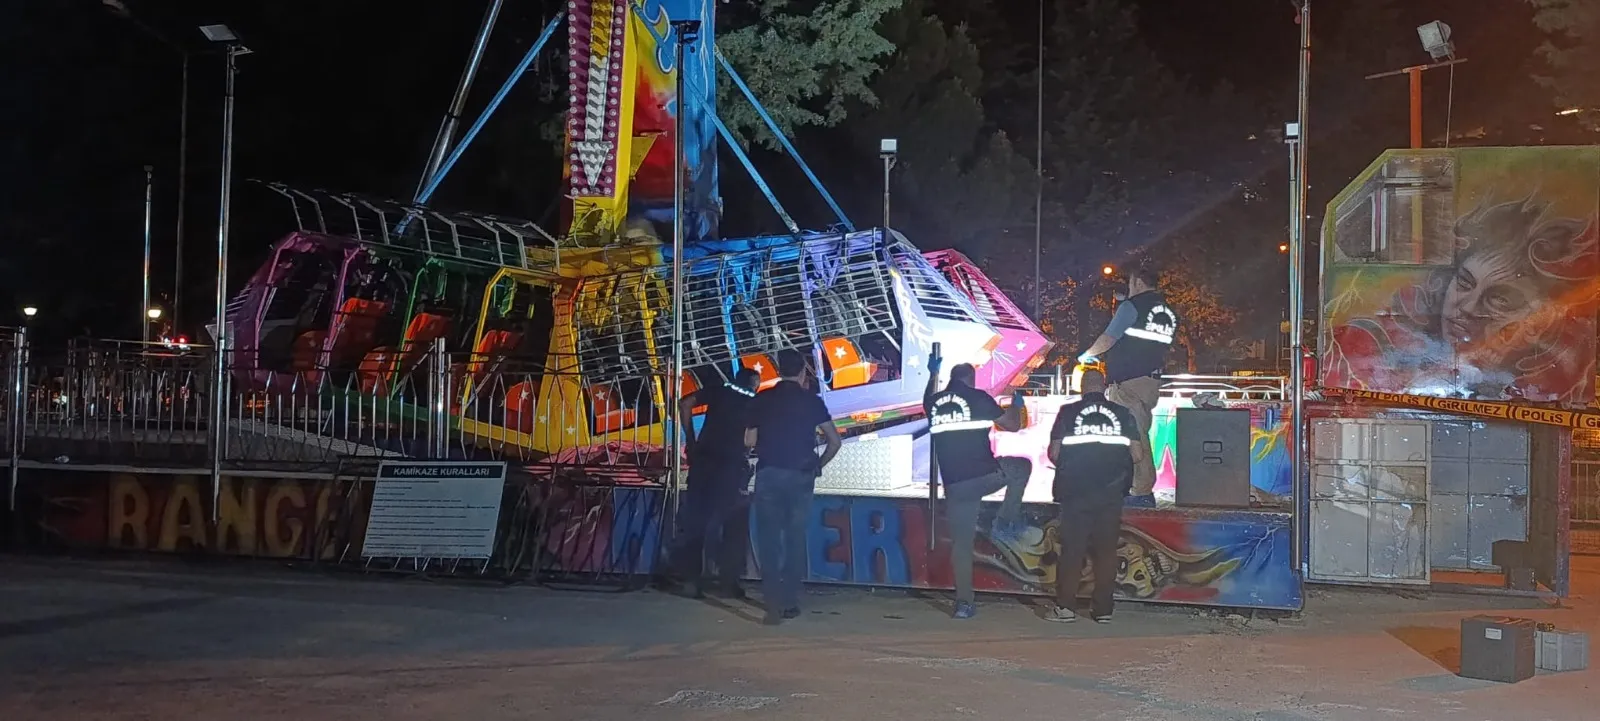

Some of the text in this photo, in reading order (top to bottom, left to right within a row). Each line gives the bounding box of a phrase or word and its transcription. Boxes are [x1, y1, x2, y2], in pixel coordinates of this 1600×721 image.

[935, 410, 963, 424] POLİS
[1081, 423, 1114, 435] POLİS
[393, 466, 491, 477] KAMİKAZE KURALLARI
